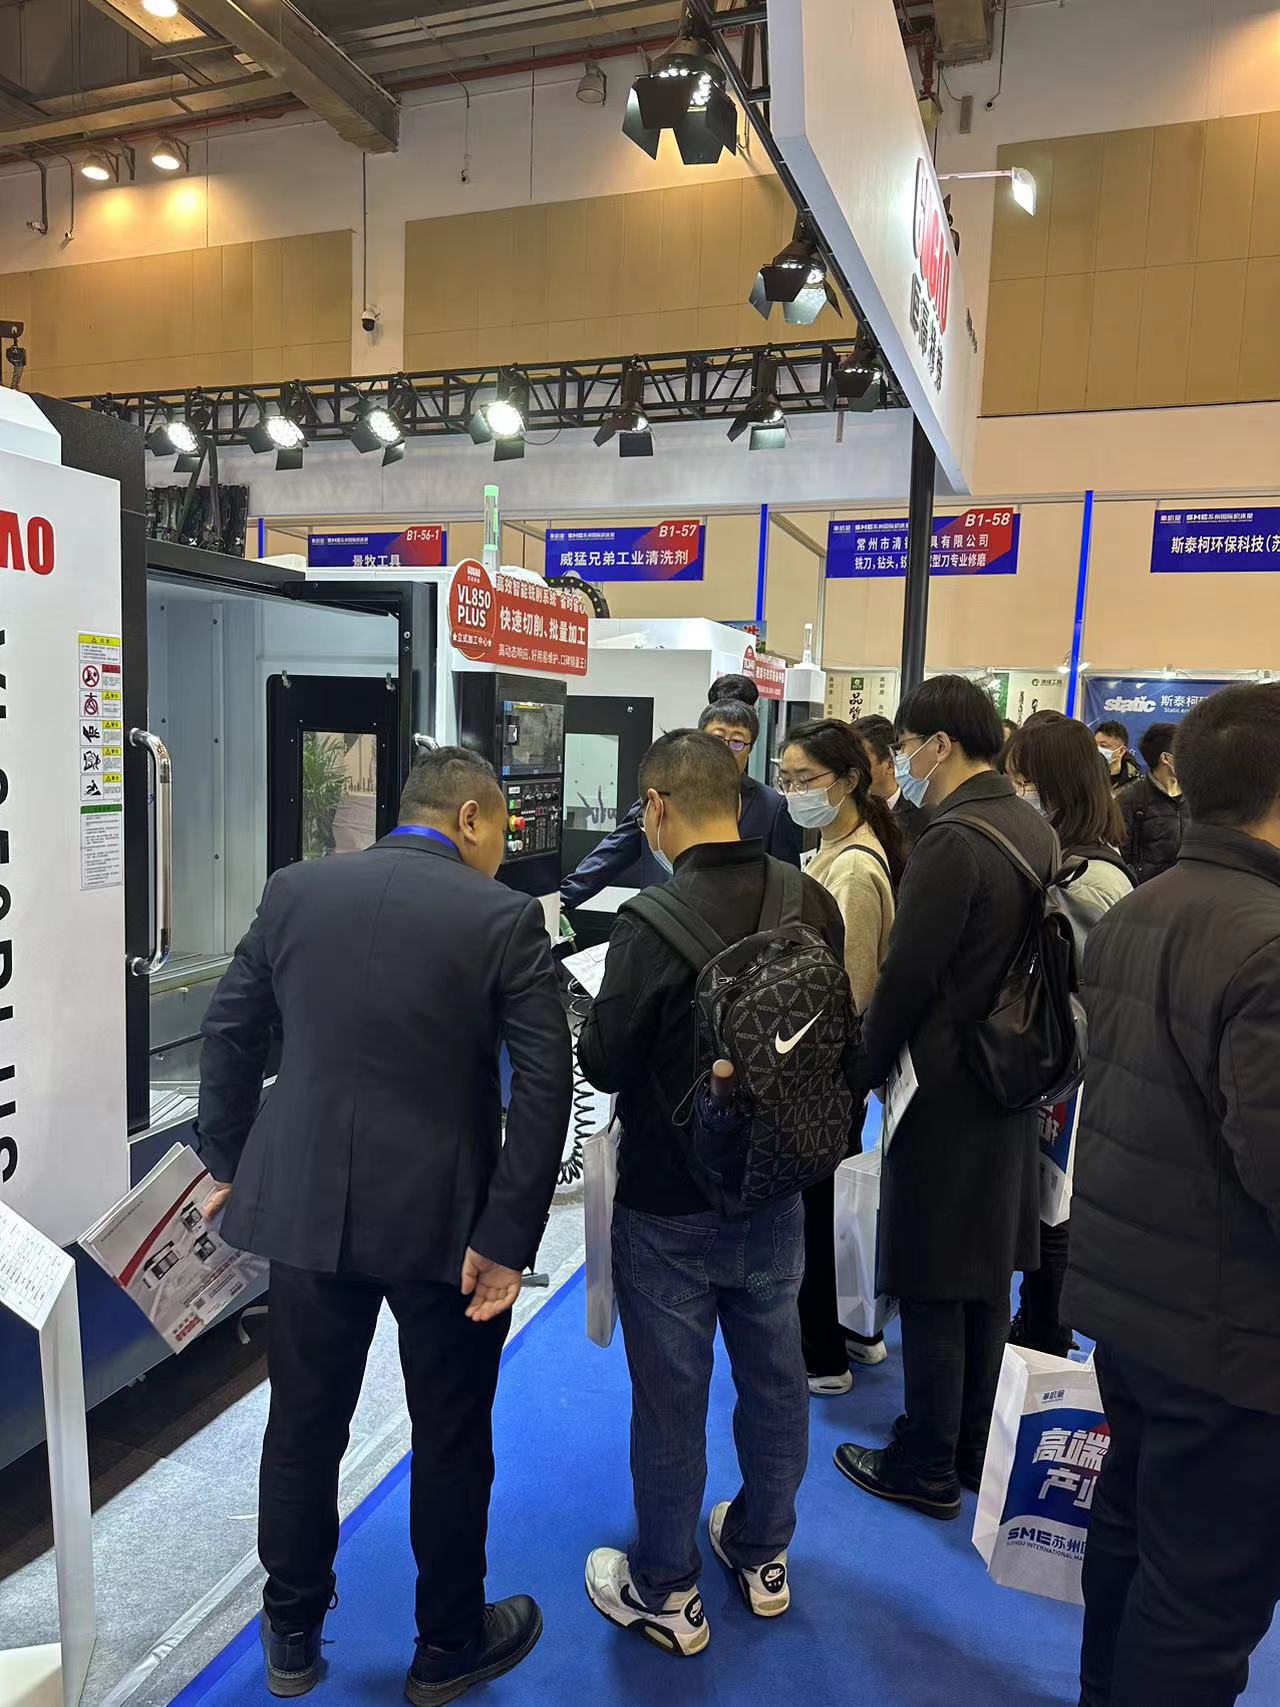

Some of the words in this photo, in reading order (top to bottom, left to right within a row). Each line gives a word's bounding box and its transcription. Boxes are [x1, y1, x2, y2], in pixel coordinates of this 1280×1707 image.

[964, 512, 1011, 528] B1-58
[406, 529, 440, 541] B1-56-1
[658, 525, 697, 538] B1-57
[856, 534, 989, 552] 常州市清具有限公司
[352, 554, 401, 567] 景牧工具
[559, 549, 688, 567] 威猛兄弟工业清洗剂
[457, 584, 492, 610] VL850
[457, 604, 487, 628] PLUS
[1032, 1427, 1110, 1471] 高端
